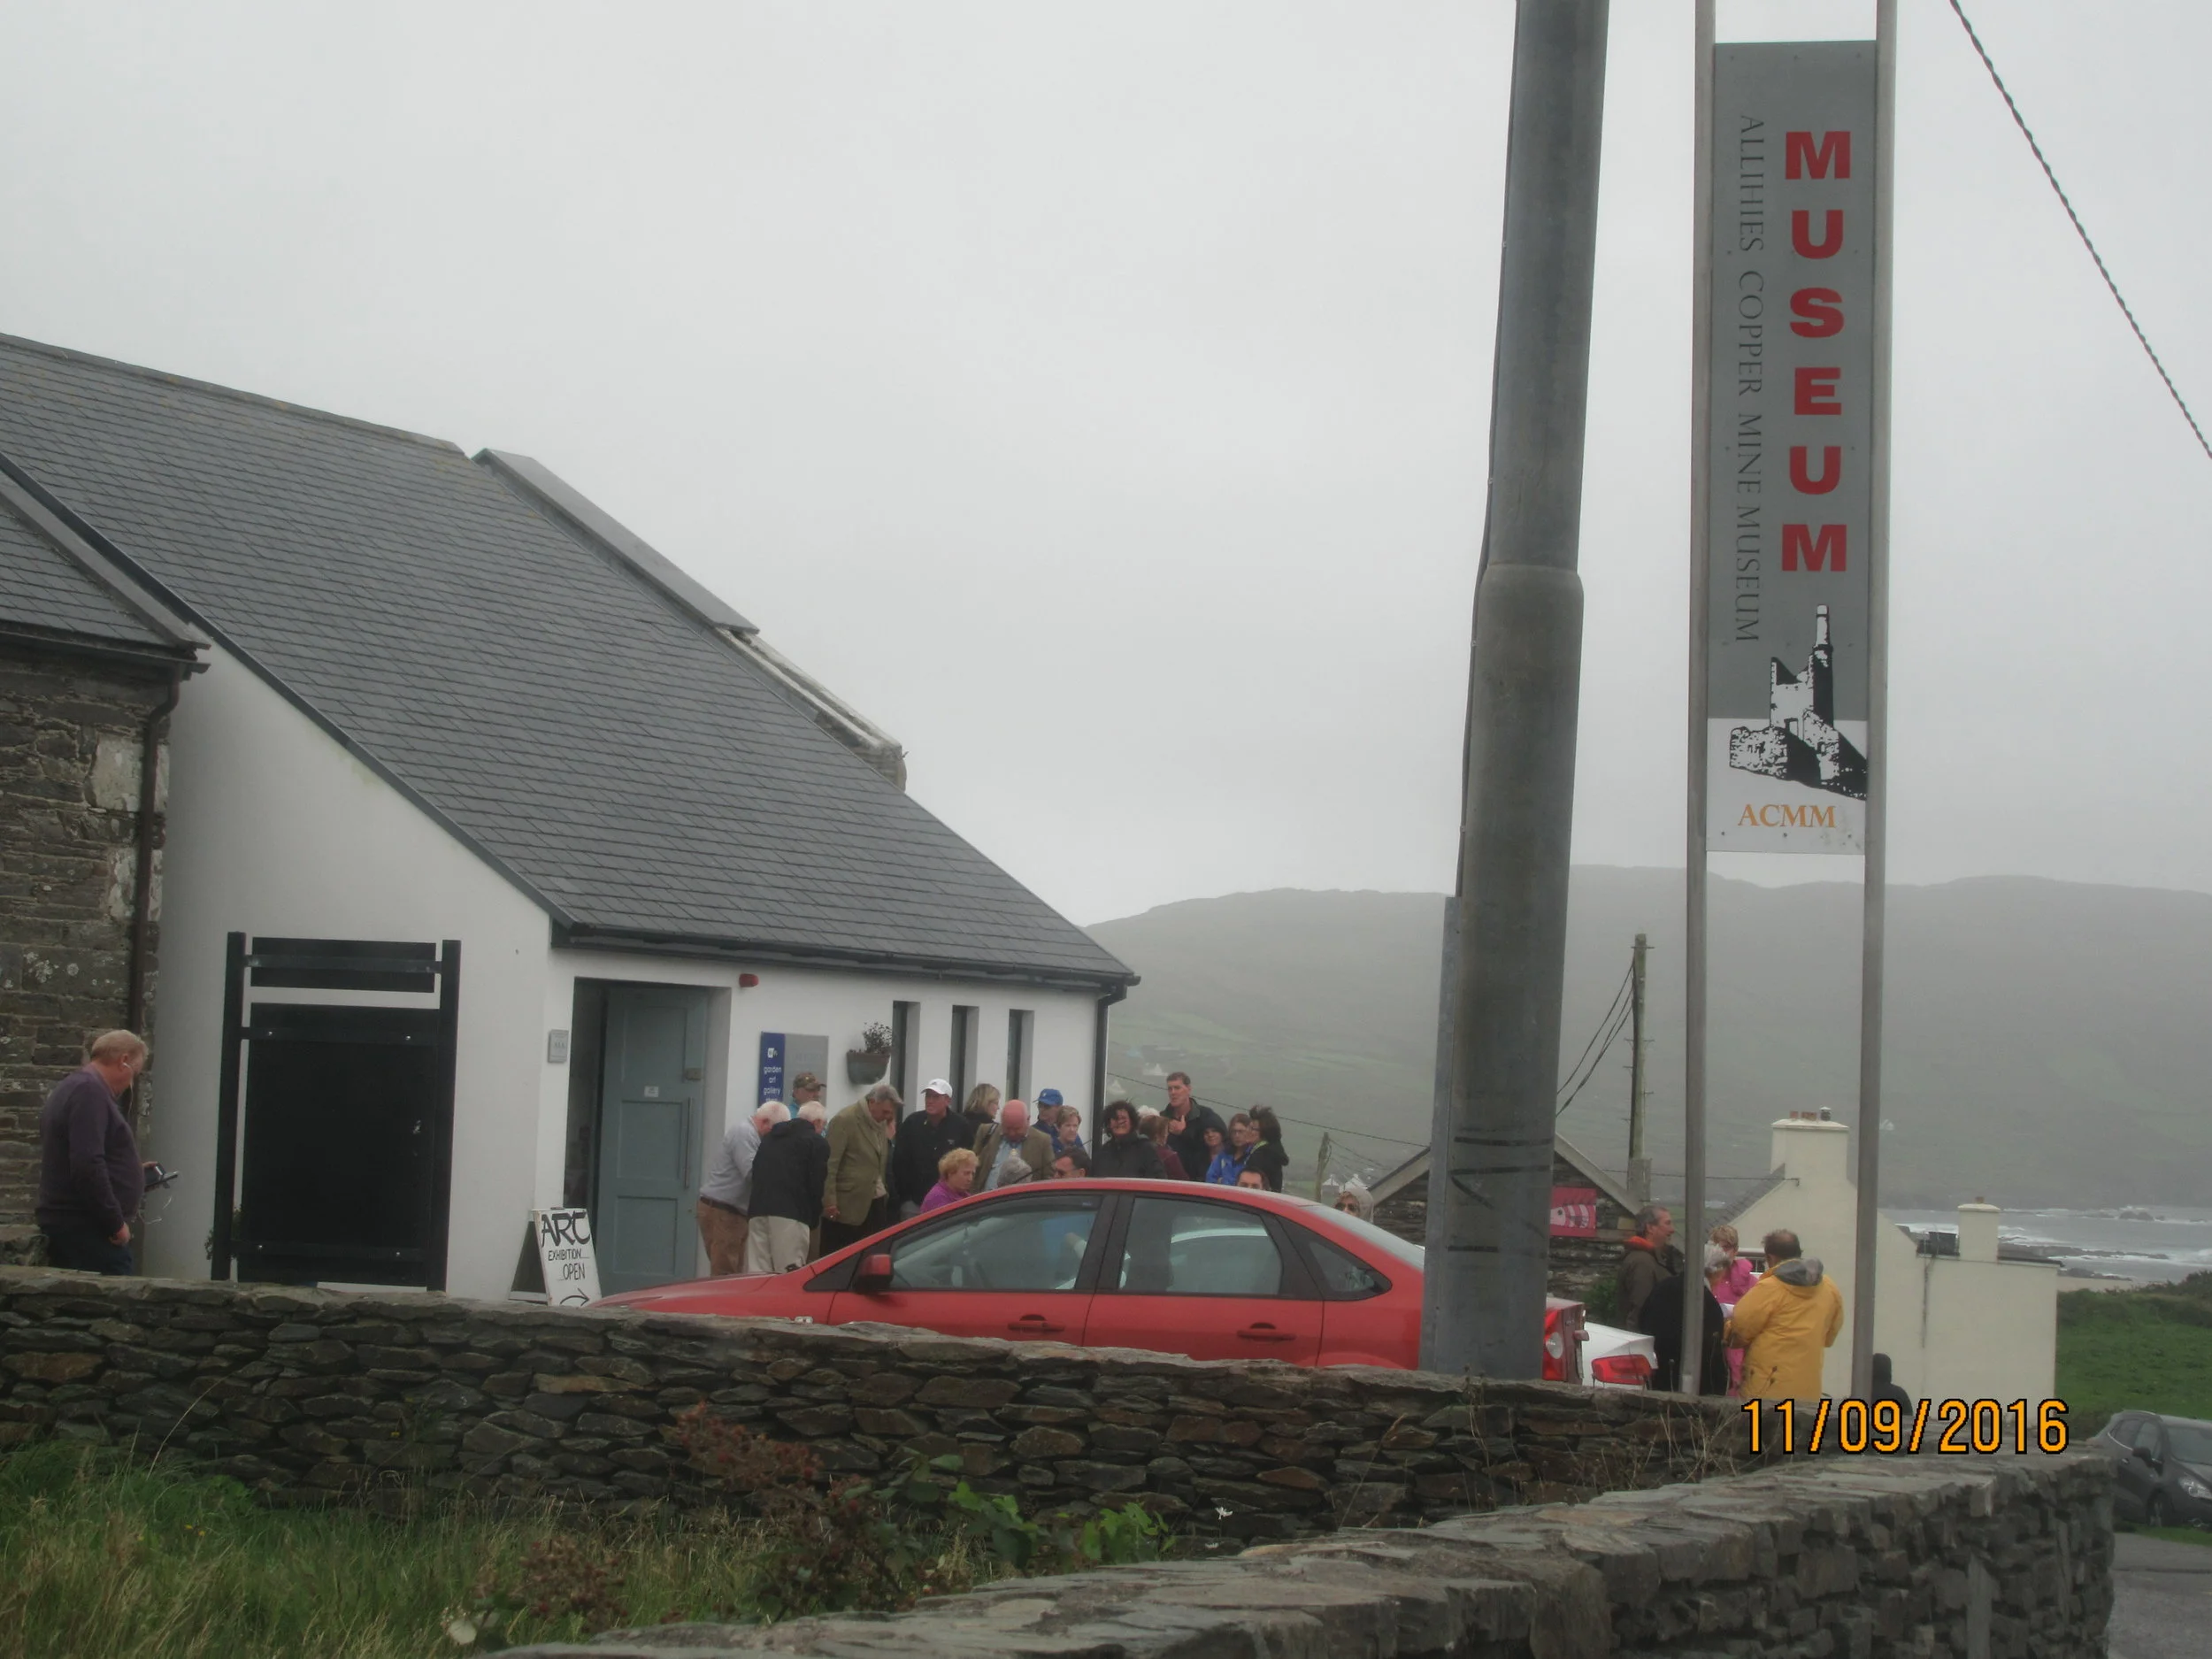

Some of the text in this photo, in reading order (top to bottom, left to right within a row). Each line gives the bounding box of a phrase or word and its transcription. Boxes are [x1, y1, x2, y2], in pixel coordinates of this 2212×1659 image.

[1781, 130, 1852, 572] MUSEUM
[1734, 114, 1765, 642] ALLIHIES COPPER MINE MUSEUM
[1737, 803, 1837, 828] ACMM
[548, 1248, 582, 1261] EXHIBITION
[562, 1263, 586, 1281] OPEN
